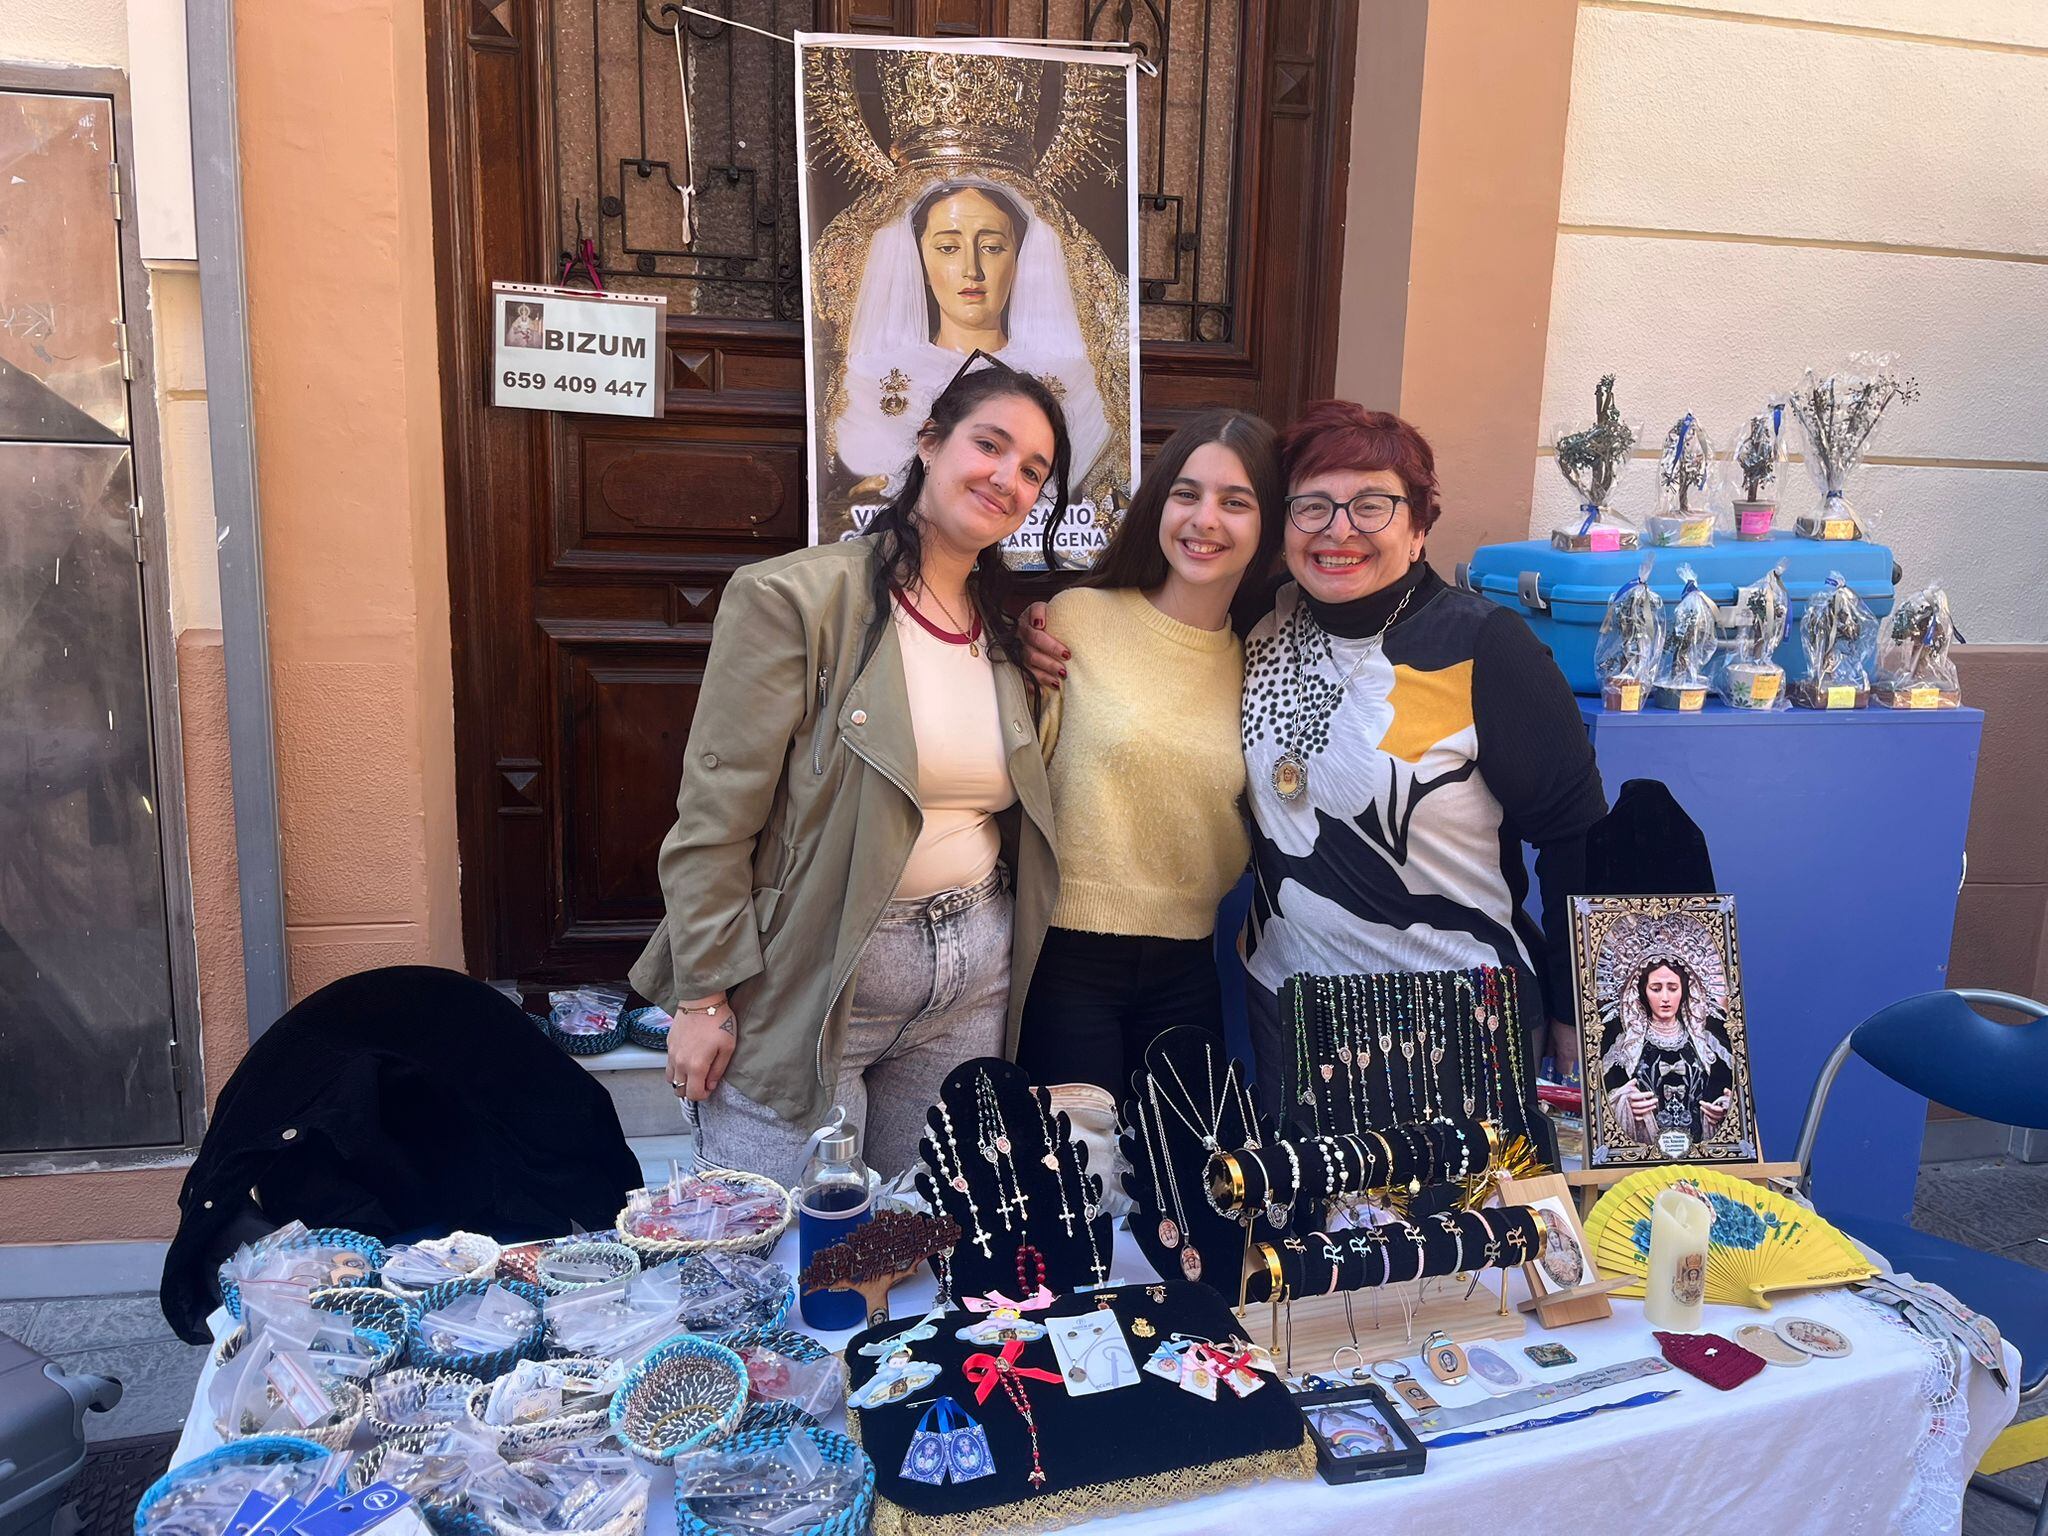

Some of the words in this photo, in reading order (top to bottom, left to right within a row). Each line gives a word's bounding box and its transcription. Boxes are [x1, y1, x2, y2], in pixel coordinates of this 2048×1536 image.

[545, 329, 646, 359] BIZUM
[503, 371, 546, 390] 659
[554, 375, 597, 394] 409
[605, 379, 647, 398] 447
[1000, 532, 1105, 548] ARTGENA
[1366, 1227, 1390, 1243] R
[1404, 1226, 1426, 1242] R
[1441, 1220, 1463, 1233] R
[1284, 1237, 1307, 1251] R
[1506, 1226, 1527, 1246] R
[1349, 1236, 1372, 1254] R
[1484, 1241, 1500, 1258] R
[1323, 1245, 1344, 1264] R
